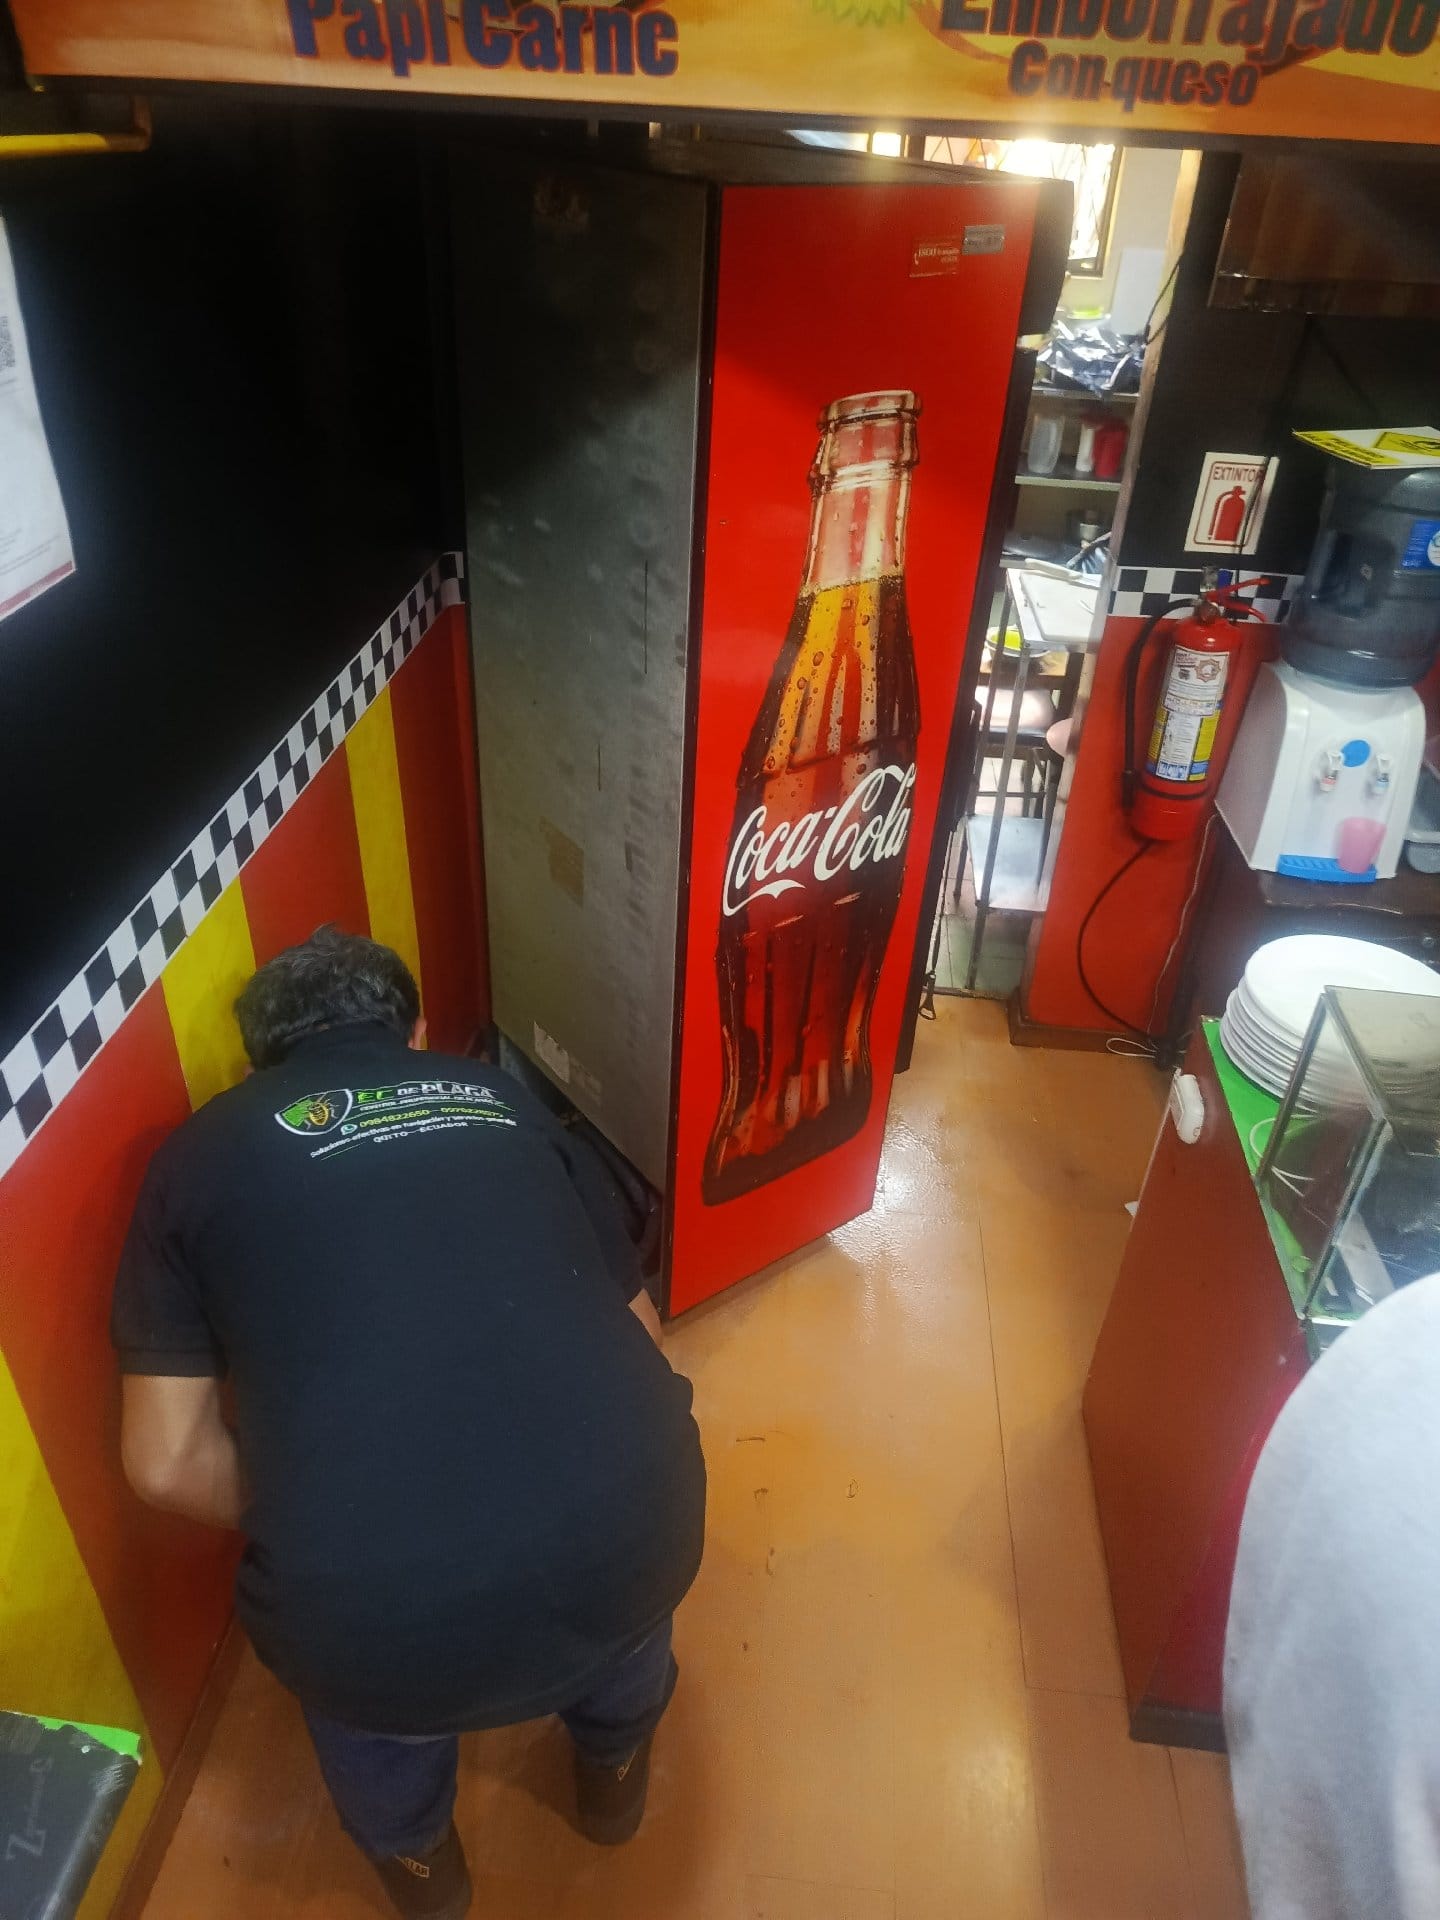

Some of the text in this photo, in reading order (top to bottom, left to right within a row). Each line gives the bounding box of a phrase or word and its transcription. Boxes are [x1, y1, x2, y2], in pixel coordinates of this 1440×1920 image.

[463, 0, 680, 77] Carne
[1008, 39, 1259, 112] Con queso
[722, 763, 917, 917] Coca-Cola
